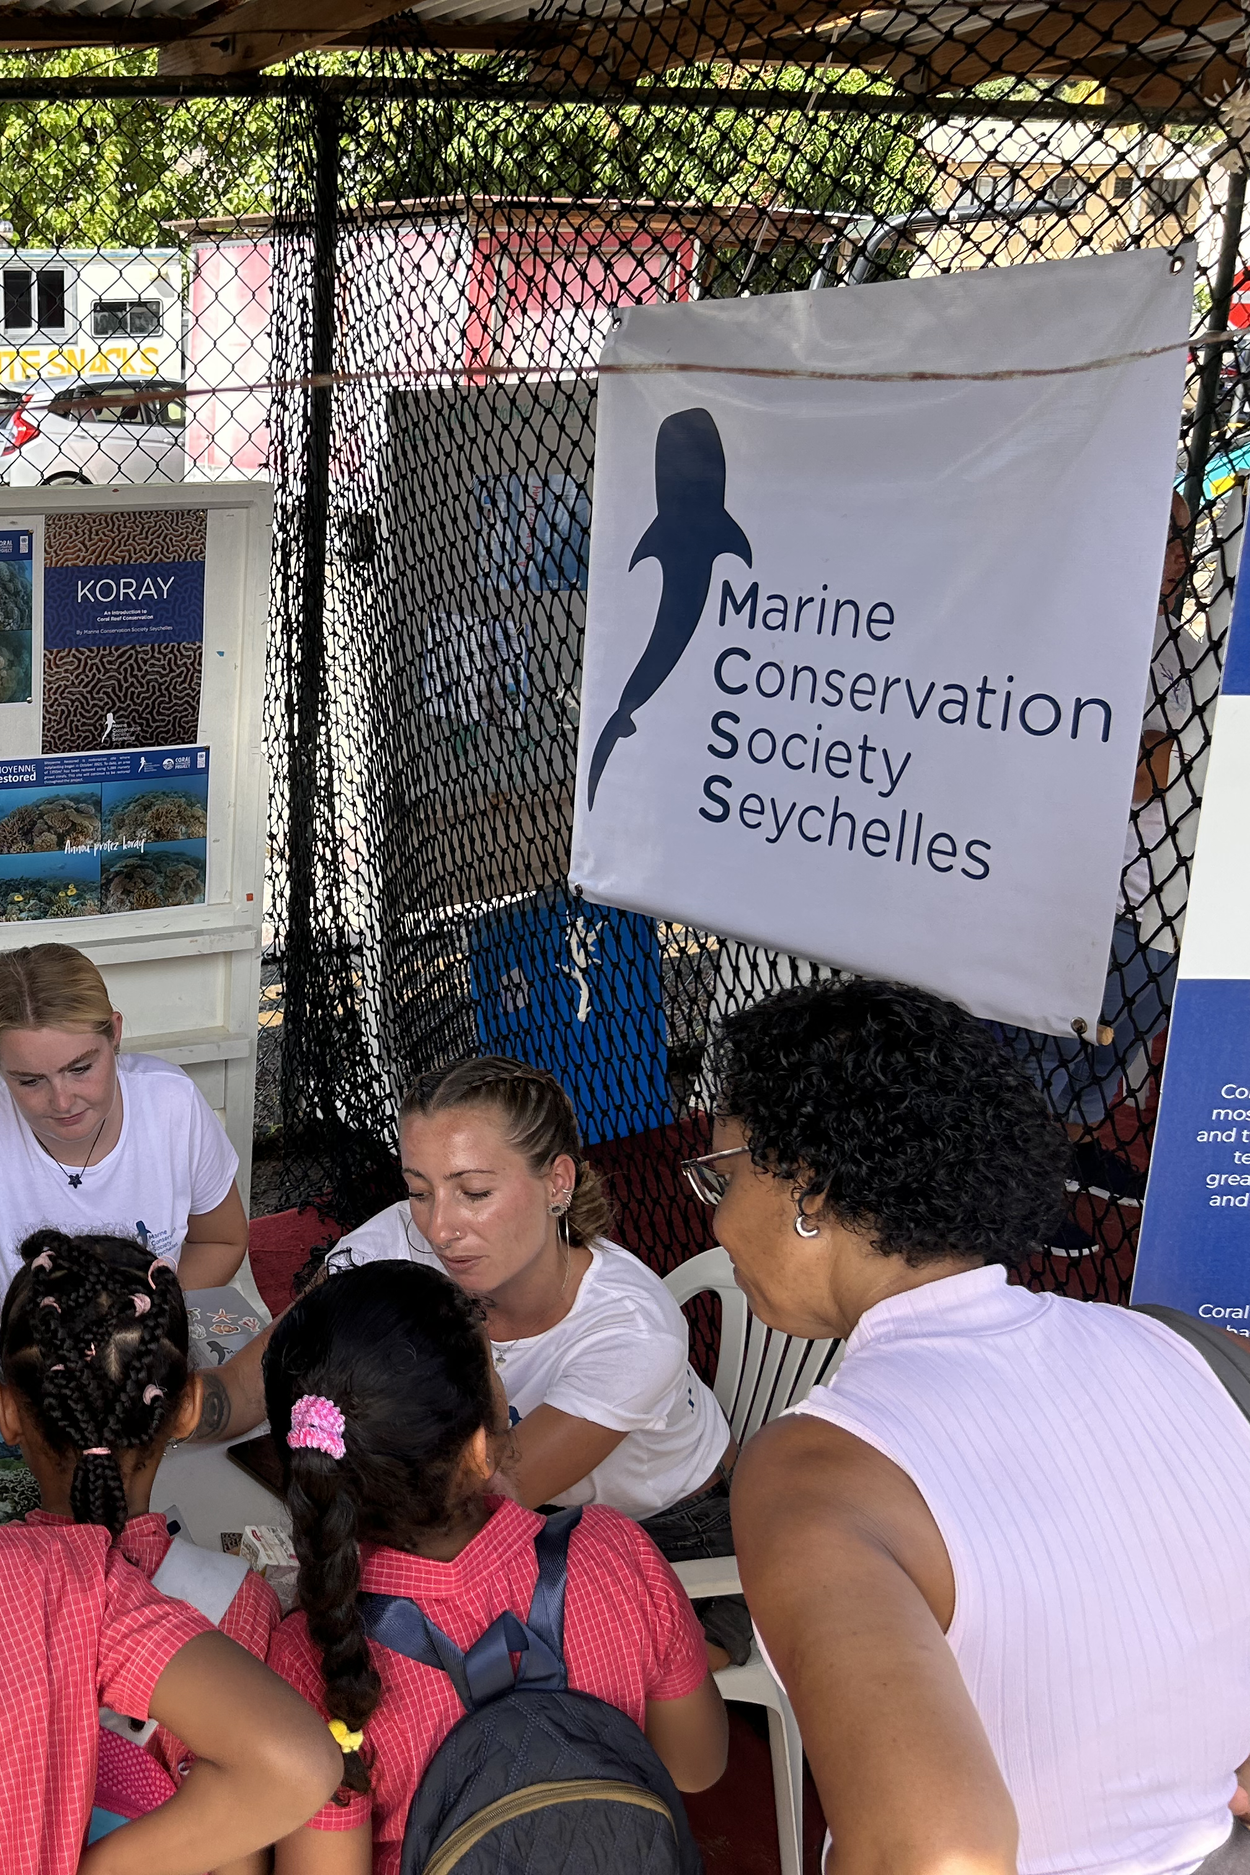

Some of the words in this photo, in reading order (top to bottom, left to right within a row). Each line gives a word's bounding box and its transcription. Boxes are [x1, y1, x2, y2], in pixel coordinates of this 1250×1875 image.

[47, 346, 159, 376] SNACKS
[77, 576, 175, 603] KORAY
[719, 579, 896, 642] Marine
[713, 647, 1113, 743] Conservation
[707, 711, 911, 798] Society
[698, 774, 992, 880] Seychelles
[64, 839, 90, 855] Annou
[93, 839, 119, 857] protez
[1221, 1083, 1250, 1099] Co
[1196, 1127, 1237, 1142] and
[1209, 1192, 1249, 1207] and
[1199, 1304, 1250, 1319] Coral
